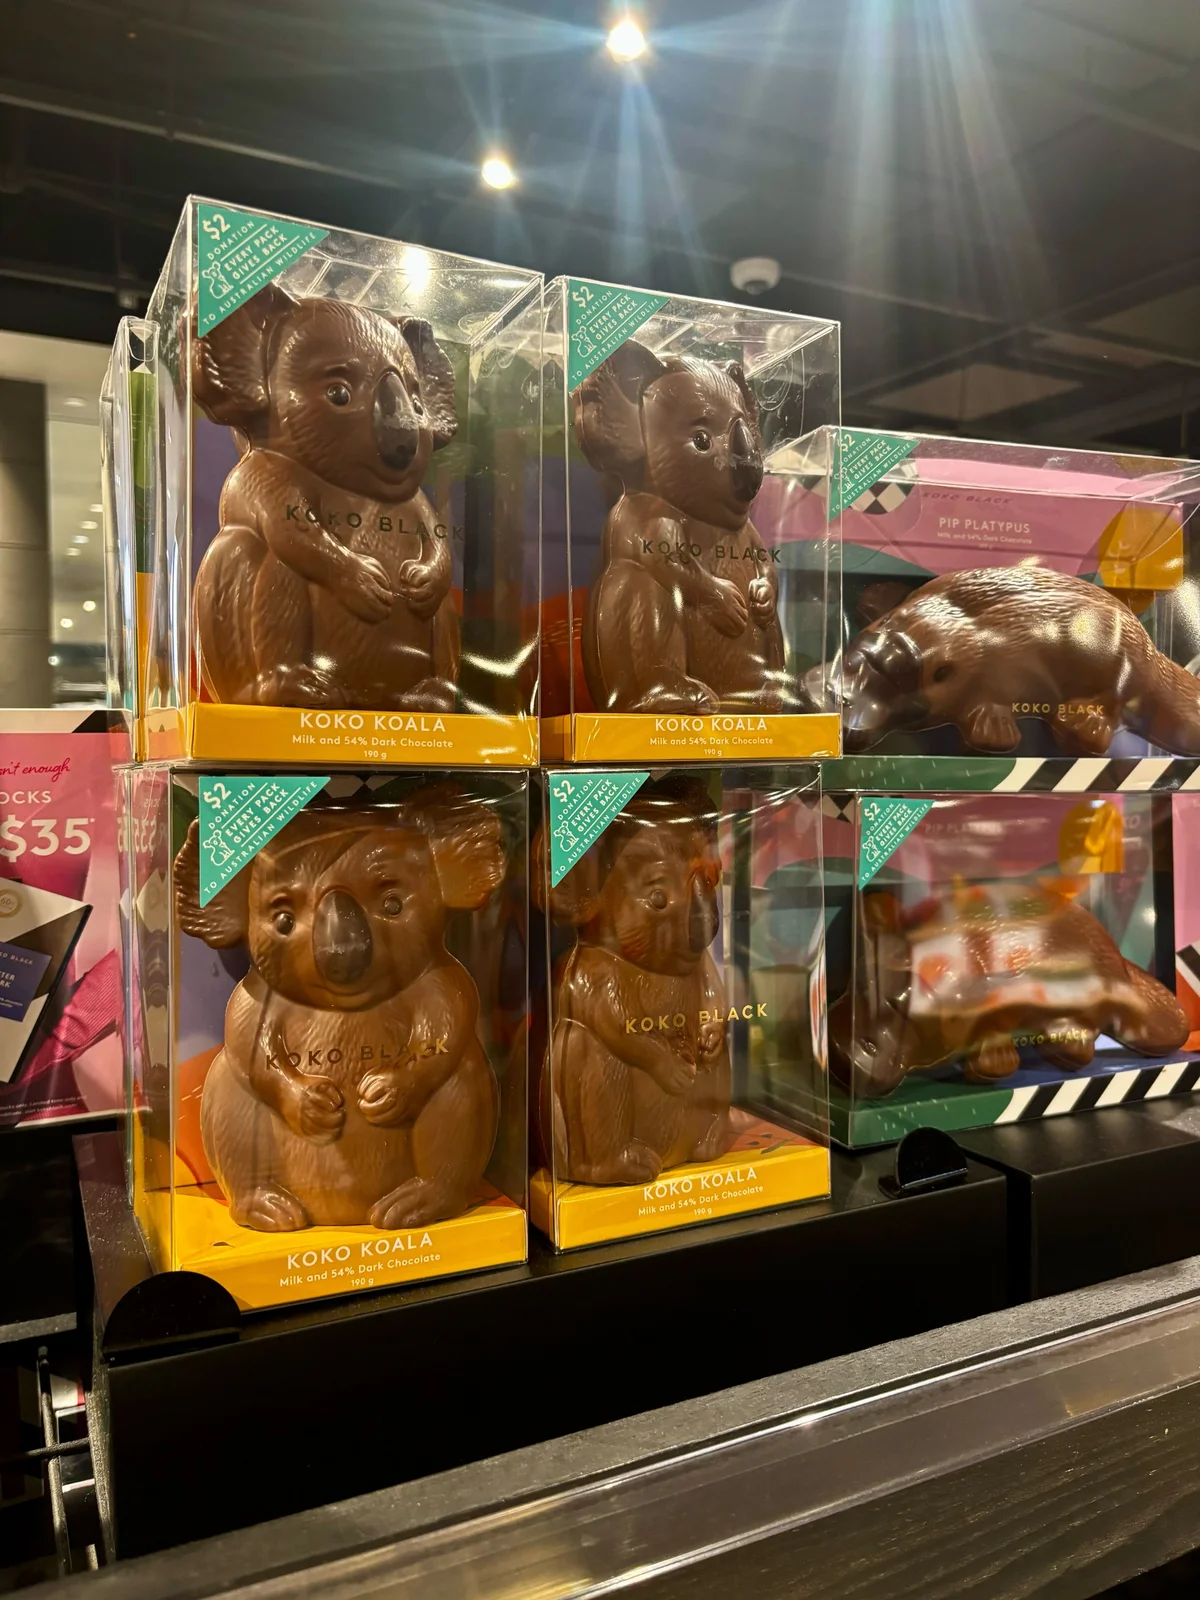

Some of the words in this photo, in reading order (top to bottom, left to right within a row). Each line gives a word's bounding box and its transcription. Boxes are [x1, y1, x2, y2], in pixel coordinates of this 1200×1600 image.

[202, 214, 231, 240] $2
[207, 220, 255, 260] DONATION
[223, 245, 254, 271] EVERY
[254, 225, 279, 248] PACK
[232, 254, 261, 280] GIVES
[261, 232, 288, 256] BACK
[202, 313, 216, 325] TO
[218, 266, 274, 314] AUSTRALIAN
[276, 232, 316, 266] WILDLIFE
[572, 286, 594, 308] $2
[576, 290, 613, 325] DONATION
[589, 311, 612, 334] EVERY
[612, 294, 631, 313] PACK
[595, 318, 618, 340] GIVES
[618, 300, 638, 320] BACK
[572, 370, 582, 381] TO
[584, 328, 628, 370] AUSTRALIAN
[628, 298, 660, 328] WILDLIFE
[286, 503, 362, 528] KOKO
[379, 516, 465, 541] BLACK
[939, 517, 960, 528] PIP
[964, 519, 1030, 534] PLATYPUS
[642, 540, 702, 558] KOKO
[715, 545, 782, 564] BLACK
[300, 712, 364, 730] KOKO
[374, 715, 446, 732] KOALA
[655, 718, 704, 732] KOKO
[711, 718, 768, 732] KOALA
[1012, 702, 1051, 714] KOKO
[1058, 704, 1105, 715] BLACK
[292, 734, 316, 744] Milk
[320, 736, 340, 745] and
[344, 736, 368, 746] 54%
[372, 737, 397, 747] Dark
[400, 738, 453, 748] Chocolate
[364, 750, 379, 758] 190
[381, 752, 387, 760] g
[650, 738, 668, 746] Milk
[670, 737, 686, 745] and
[710, 737, 729, 745] Dark
[732, 736, 774, 745] Chocolate
[22, 757, 70, 782] enough
[202, 782, 232, 809] $2
[208, 782, 256, 830] DONATION
[553, 780, 576, 803] $2
[558, 779, 594, 821] DONATION
[571, 800, 594, 827] EVERY
[593, 778, 613, 800] PACK
[577, 807, 600, 832] GIVES
[600, 784, 620, 806] BACK
[225, 807, 254, 837] EVERY
[254, 782, 280, 808] PACK
[233, 815, 262, 844] GIVES
[262, 788, 289, 814] BACK
[554, 865, 566, 876] TO
[567, 814, 610, 864] AUSTRALIAN
[610, 776, 641, 813] WILDLIFE
[864, 802, 881, 821] $2
[866, 802, 894, 836] DONATION
[875, 820, 893, 842] EVERY
[892, 803, 908, 821] PACK
[204, 882, 218, 894] TO
[220, 823, 276, 880] AUSTRALIAN
[276, 780, 318, 822] WILDLIFE
[862, 872, 870, 882] TO
[870, 832, 904, 872] AUSTRALIAN
[904, 803, 929, 832] WILDLIFE
[880, 826, 897, 847] GIVES
[897, 808, 912, 827] BACK
[625, 1012, 686, 1034] KOKO
[698, 1002, 768, 1025] BLACK
[266, 1048, 344, 1071] KOKO
[638, 1206, 656, 1216] Milk
[659, 1202, 676, 1212] and
[678, 1198, 696, 1208] 54%
[699, 1194, 720, 1204] Dark
[722, 1185, 764, 1200] Chocolate
[643, 1178, 694, 1201] KOKO
[700, 1166, 758, 1190] KOALA
[694, 1208, 706, 1216] 190
[287, 1245, 351, 1270] KOKO
[361, 1232, 434, 1258] KOALA
[280, 1276, 303, 1287] Milk
[306, 1271, 328, 1282] and
[331, 1266, 355, 1278] 54%
[358, 1262, 384, 1274] Dark
[387, 1253, 441, 1269] Chocolate
[351, 1278, 366, 1287] 190
[368, 1278, 374, 1286] g
